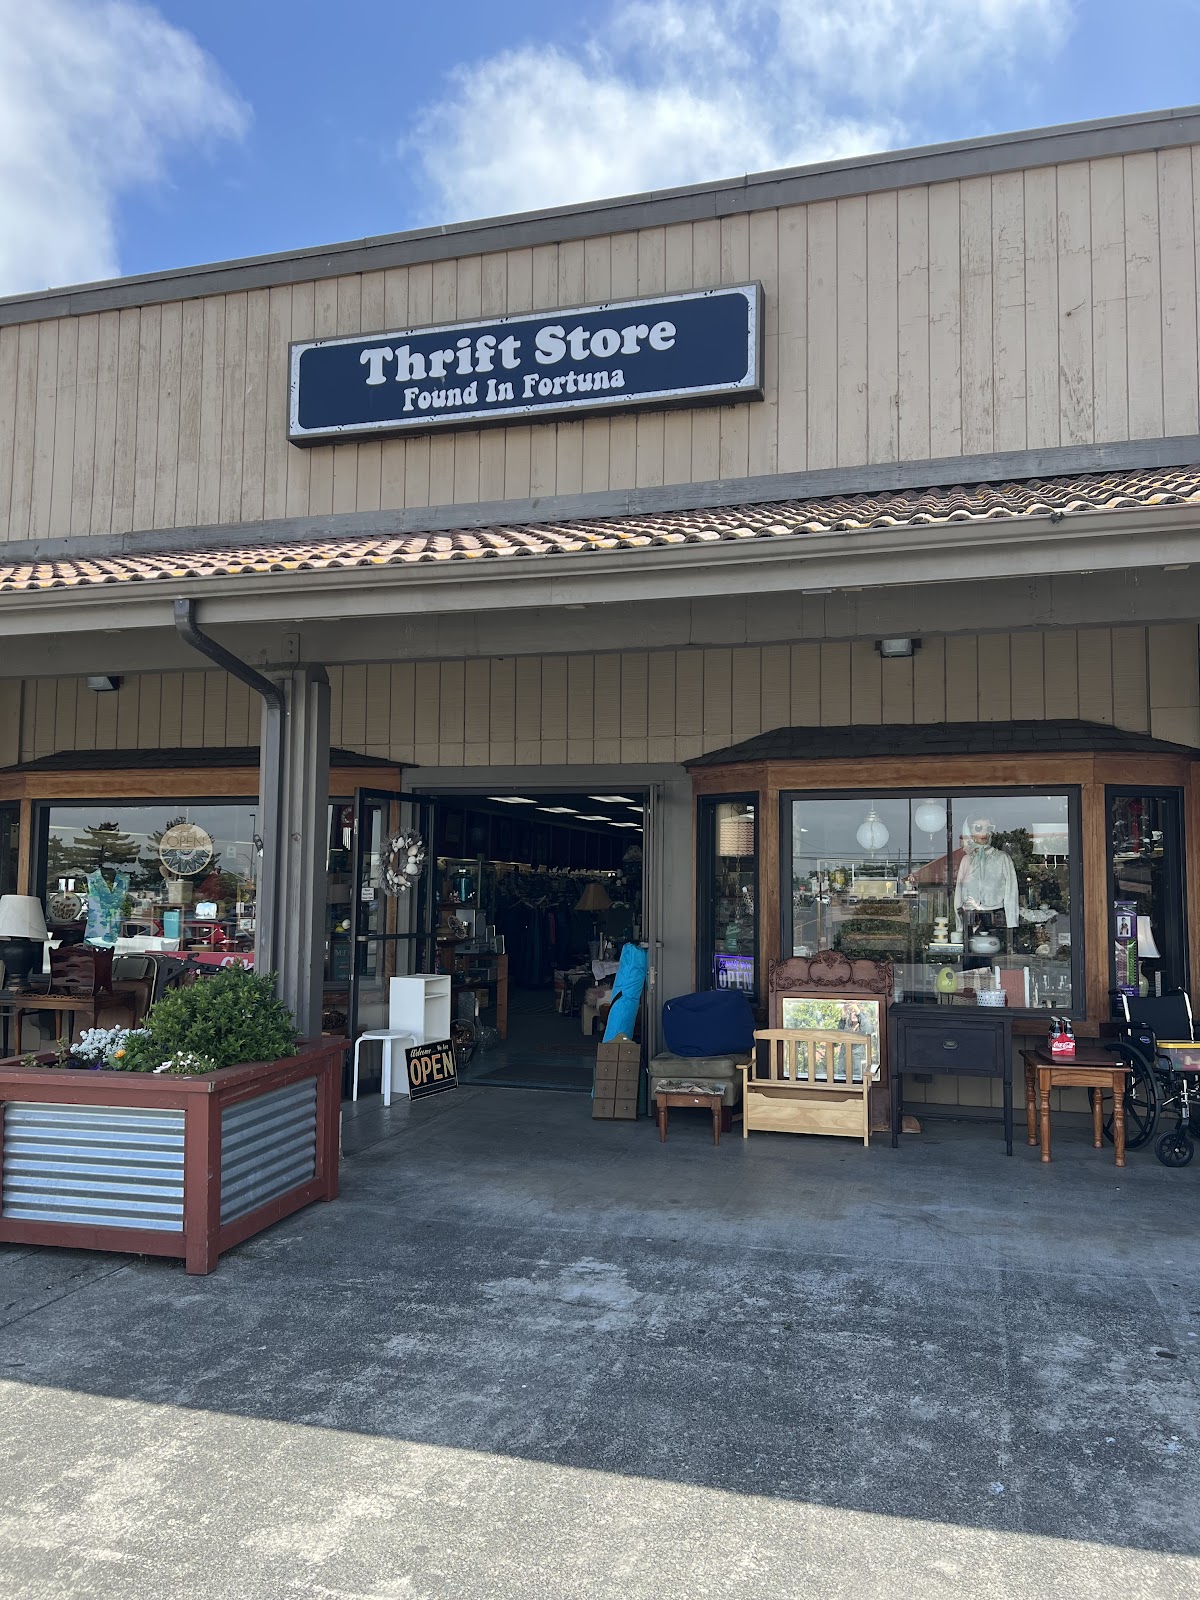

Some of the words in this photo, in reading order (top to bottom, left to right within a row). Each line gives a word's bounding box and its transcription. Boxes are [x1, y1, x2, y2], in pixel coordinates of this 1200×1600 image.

[360, 334, 521, 386] Thrift
[534, 321, 677, 365] Store
[402, 380, 478, 412] Found
[485, 378, 515, 403] In
[522, 369, 626, 398] Fortuna
[166, 836, 206, 848] OPEN
[719, 970, 752, 990] OPEN
[410, 1051, 454, 1085] OPEN
